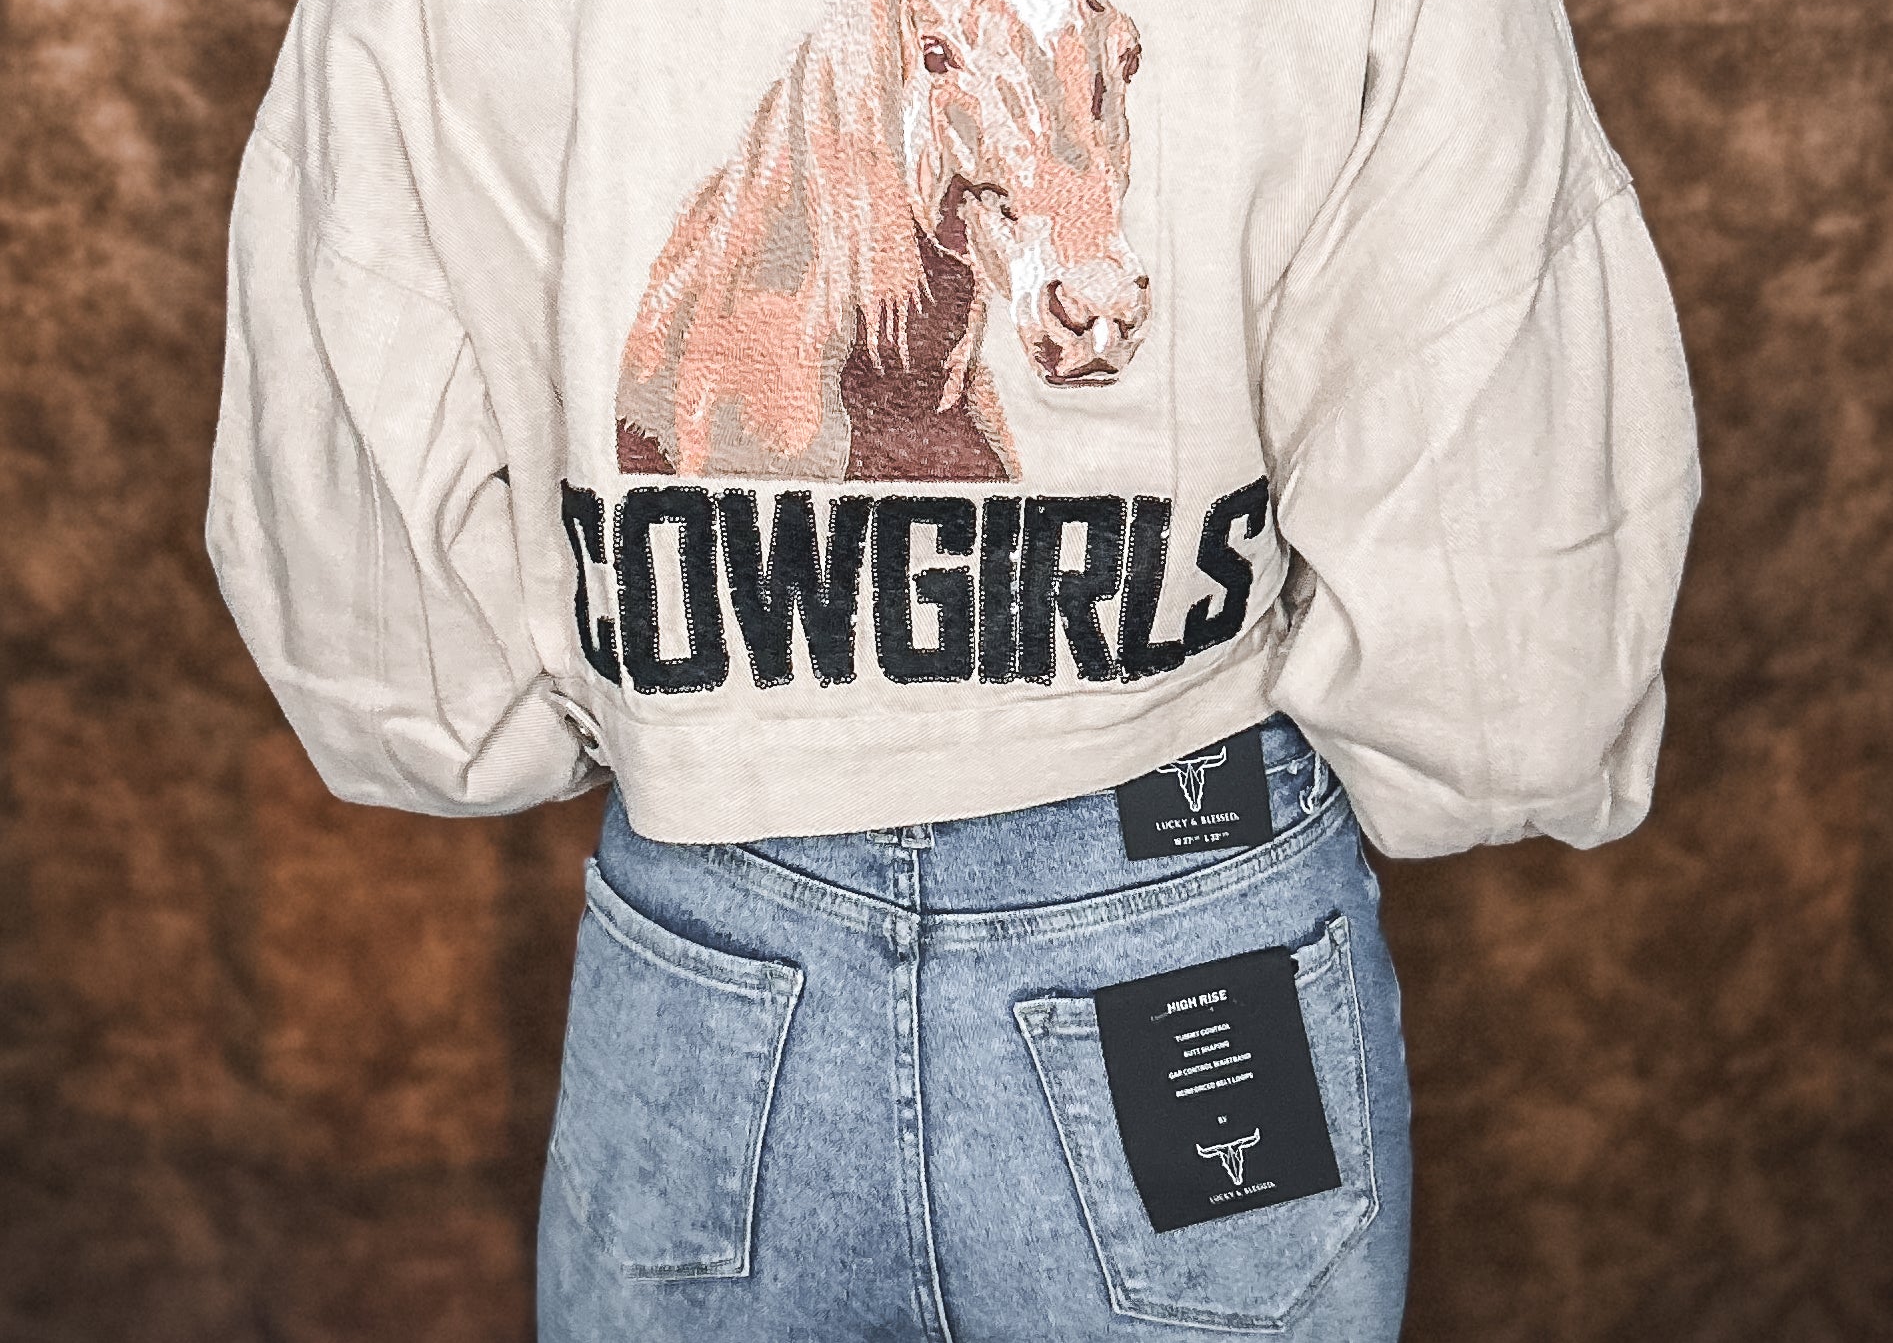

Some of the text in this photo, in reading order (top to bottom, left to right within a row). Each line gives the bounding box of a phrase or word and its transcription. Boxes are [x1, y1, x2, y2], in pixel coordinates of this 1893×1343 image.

[561, 477, 1270, 695] COWGIRLS
[1155, 819, 1188, 831] LUCKY
[1166, 989, 1228, 1015] HIGH RISE
[1200, 1022, 1231, 1037] CONTROL
[1182, 1062, 1213, 1076] CONTROL
[1209, 1191, 1234, 1204] LUCKY
